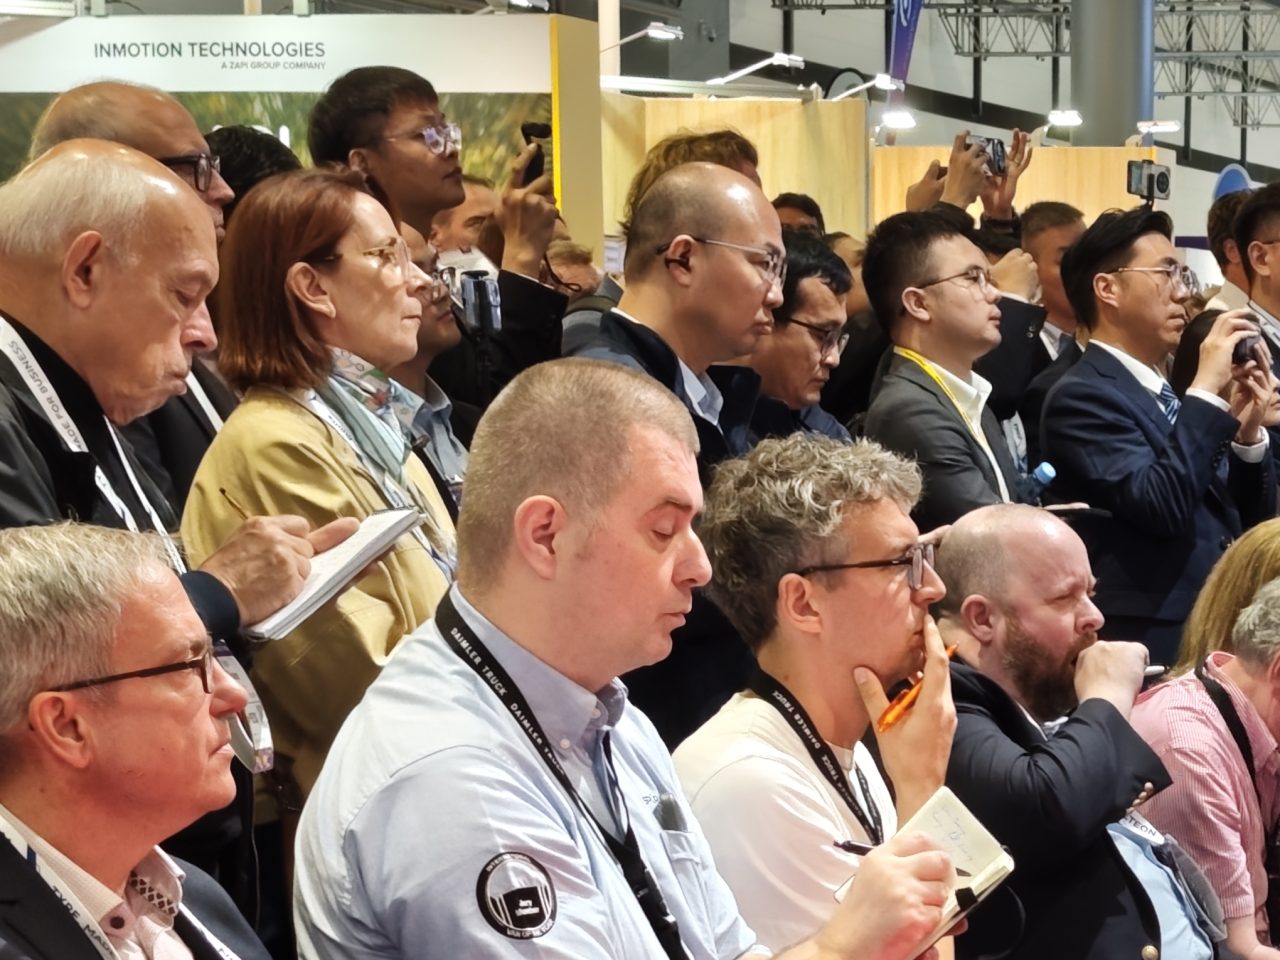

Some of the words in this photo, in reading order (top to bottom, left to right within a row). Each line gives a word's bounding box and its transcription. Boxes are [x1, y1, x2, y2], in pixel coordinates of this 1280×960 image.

[94, 43, 182, 57] INMOTION
[188, 42, 326, 57] TECHNOLOGIES
[283, 62, 326, 70] COMPANY
[9, 340, 48, 394] BUSINESS
[45, 396, 62, 421] FOR
[451, 627, 483, 665] DAIMLER
[482, 666, 508, 696] TRUCK
[772, 690, 795, 713] TRUCK
[510, 703, 543, 744] DAIMLER
[793, 714, 821, 750] DAIMLER
[821, 754, 839, 781] TRUCK
